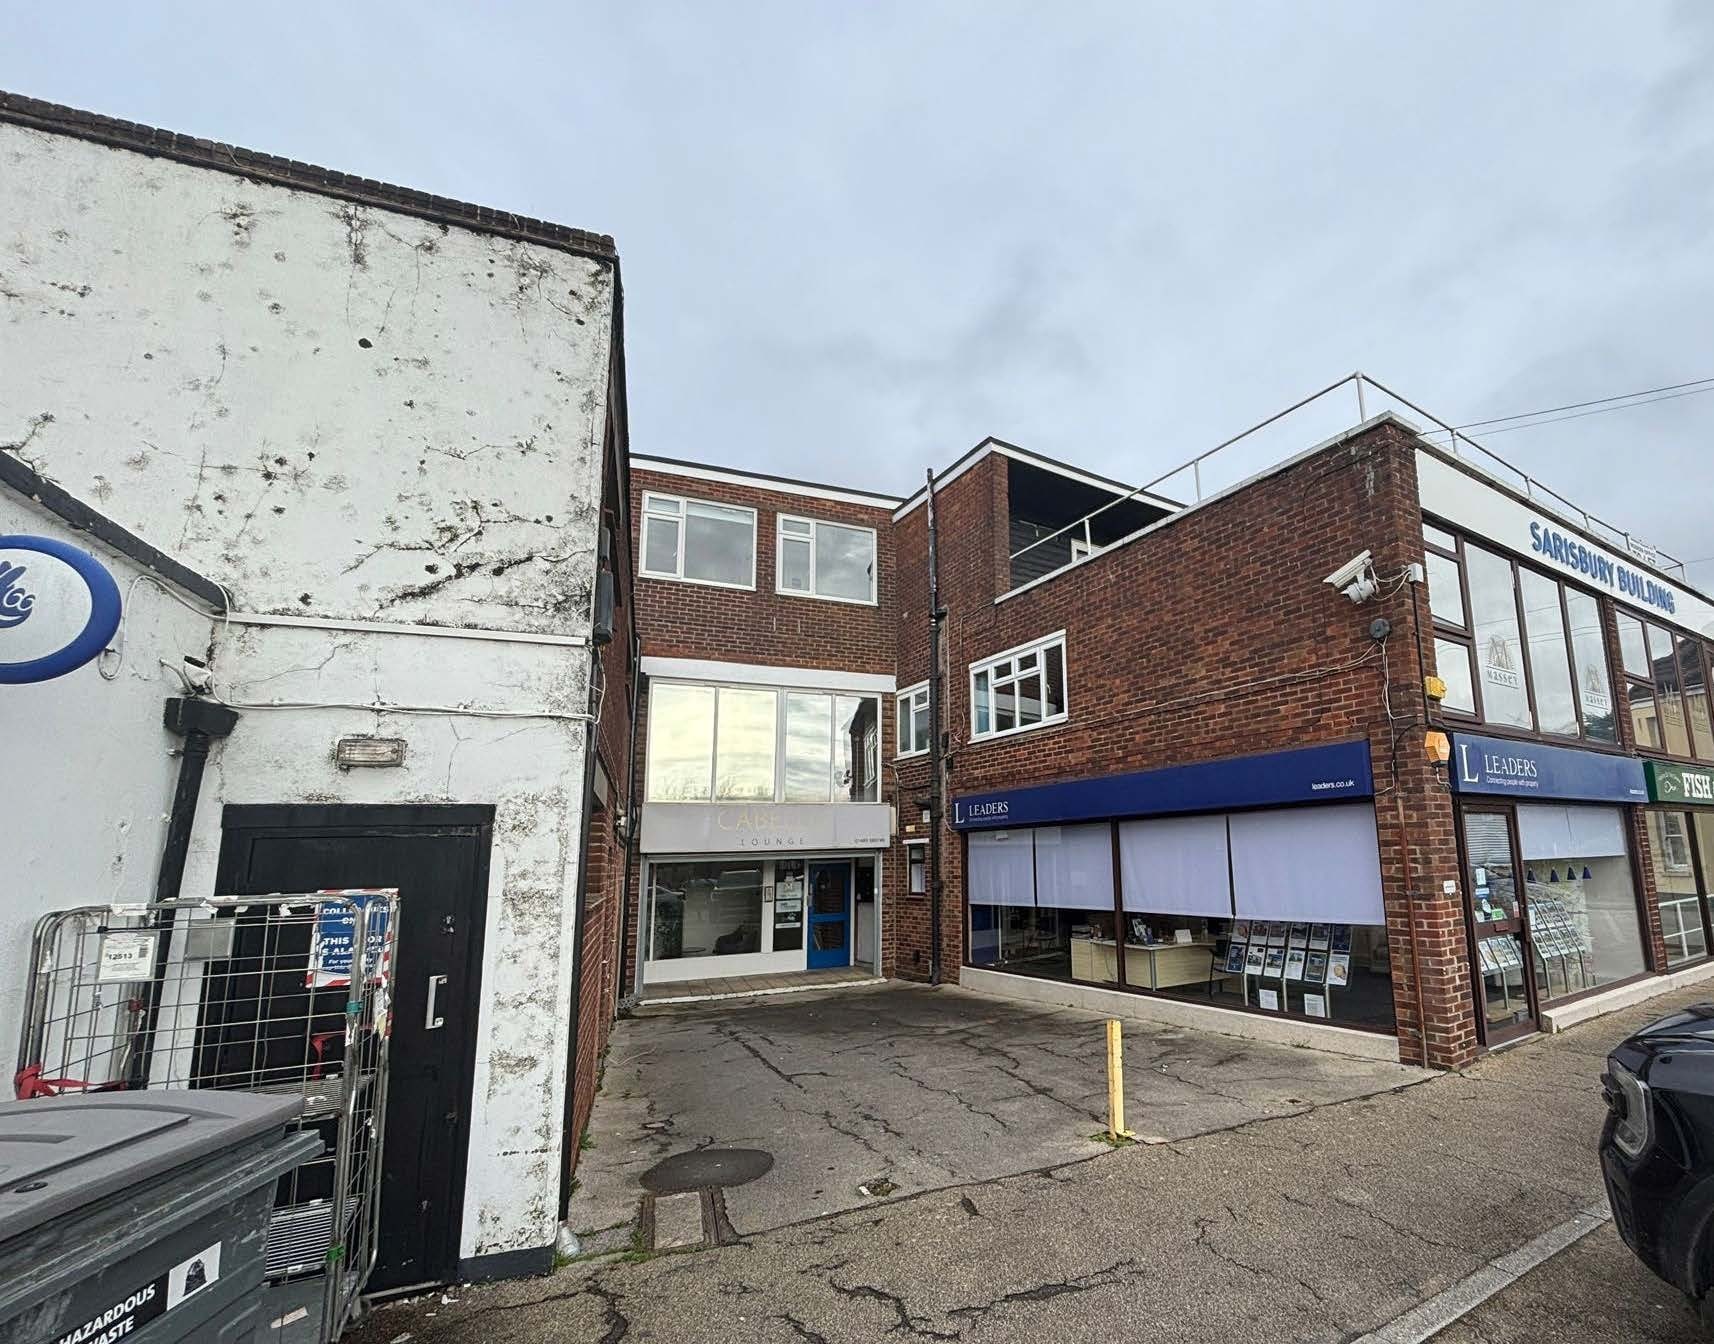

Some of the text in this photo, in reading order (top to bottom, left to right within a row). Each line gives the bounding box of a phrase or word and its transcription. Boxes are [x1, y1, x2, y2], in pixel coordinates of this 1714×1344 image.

[1529, 521, 1676, 615] SARISBURY BUILDING
[1459, 744, 1538, 783] L LEADERS
[1311, 779, 1355, 790] leaders.co.uk
[1681, 772, 1713, 799] FISH
[954, 801, 1009, 824] L LEADERS
[740, 837, 805, 847] LOUNGE
[323, 936, 350, 945] THIS
[59, 1283, 156, 1344] HAZARDOUS
